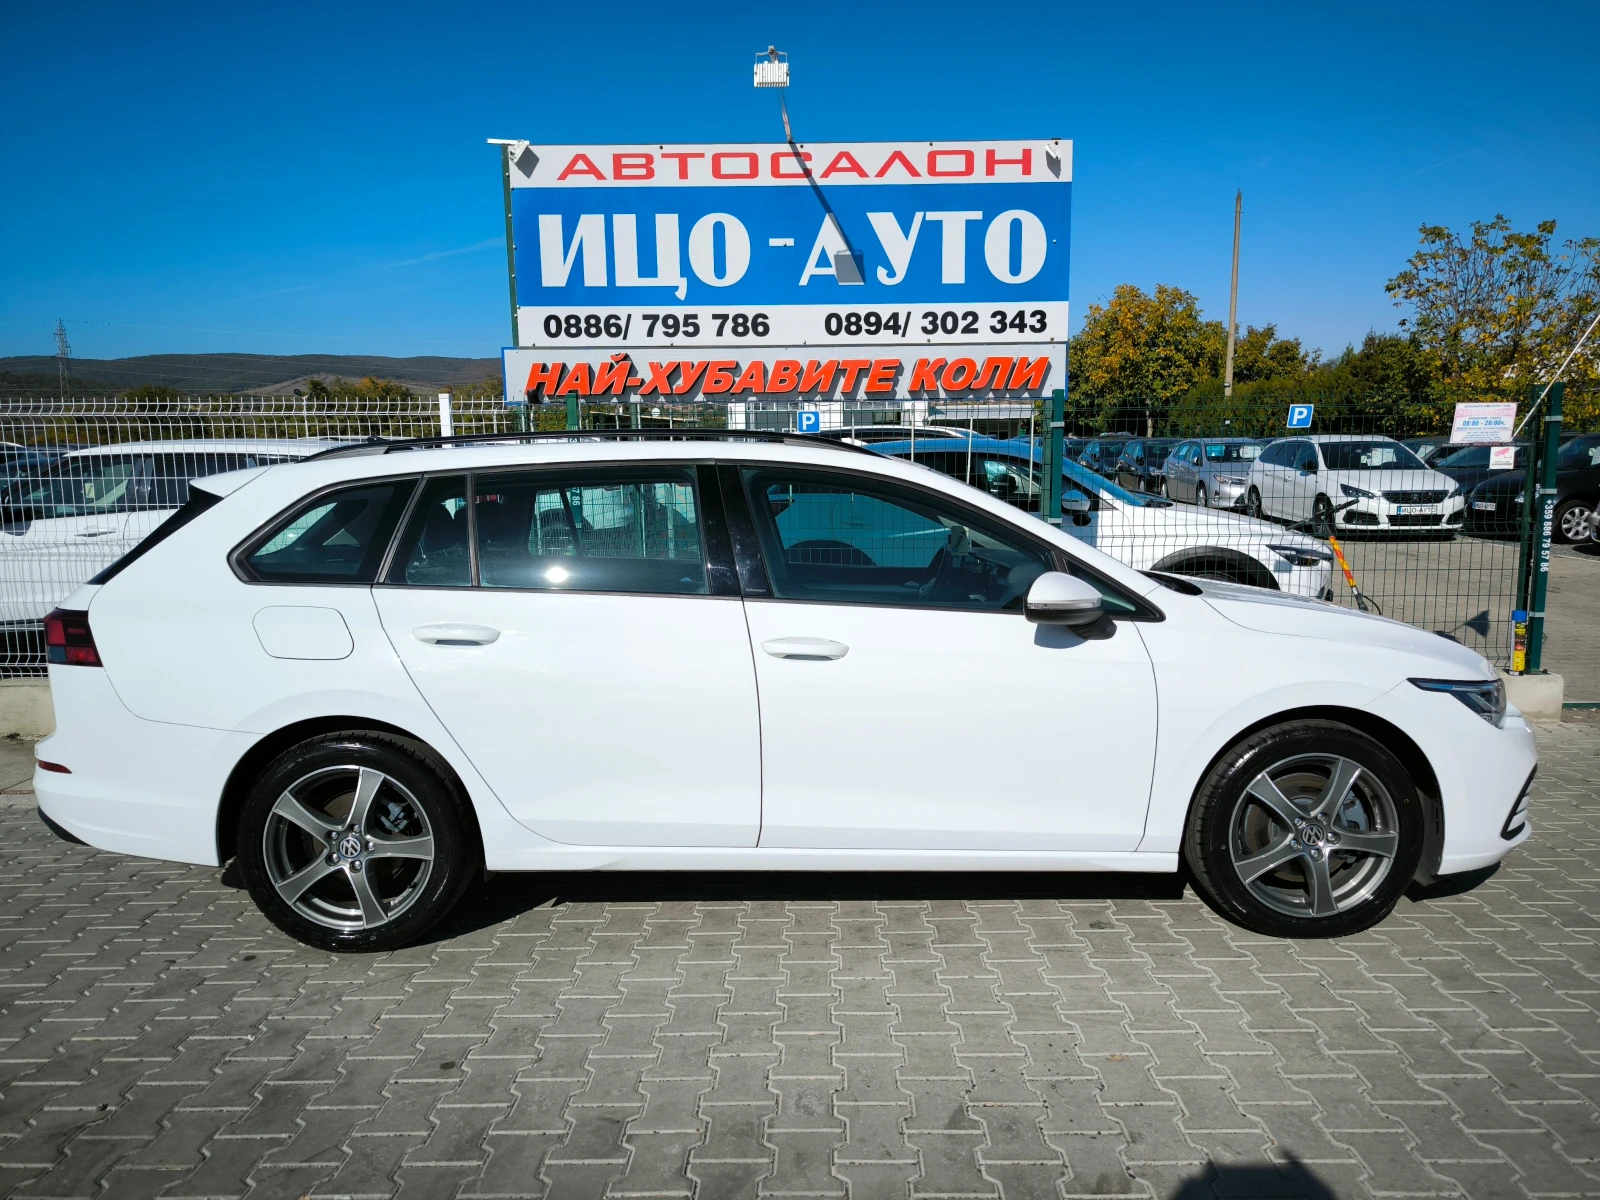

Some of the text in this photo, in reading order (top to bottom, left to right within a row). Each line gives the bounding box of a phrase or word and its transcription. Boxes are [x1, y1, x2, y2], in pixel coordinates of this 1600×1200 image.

[556, 148, 1032, 181] АВТОСАЛОН
[543, 312, 771, 340] 0886/ 795 786
[824, 309, 1048, 338] 0894/ 302 343
[524, 352, 1050, 396] НАЙ-ХУБАВИТЕ КОЛИ
[802, 413, 816, 431] P
[1292, 407, 1308, 425] P
[1542, 521, 1552, 536] 886
[1541, 538, 1551, 548] 79
[1541, 550, 1550, 560] 57
[1540, 562, 1549, 572] 86
